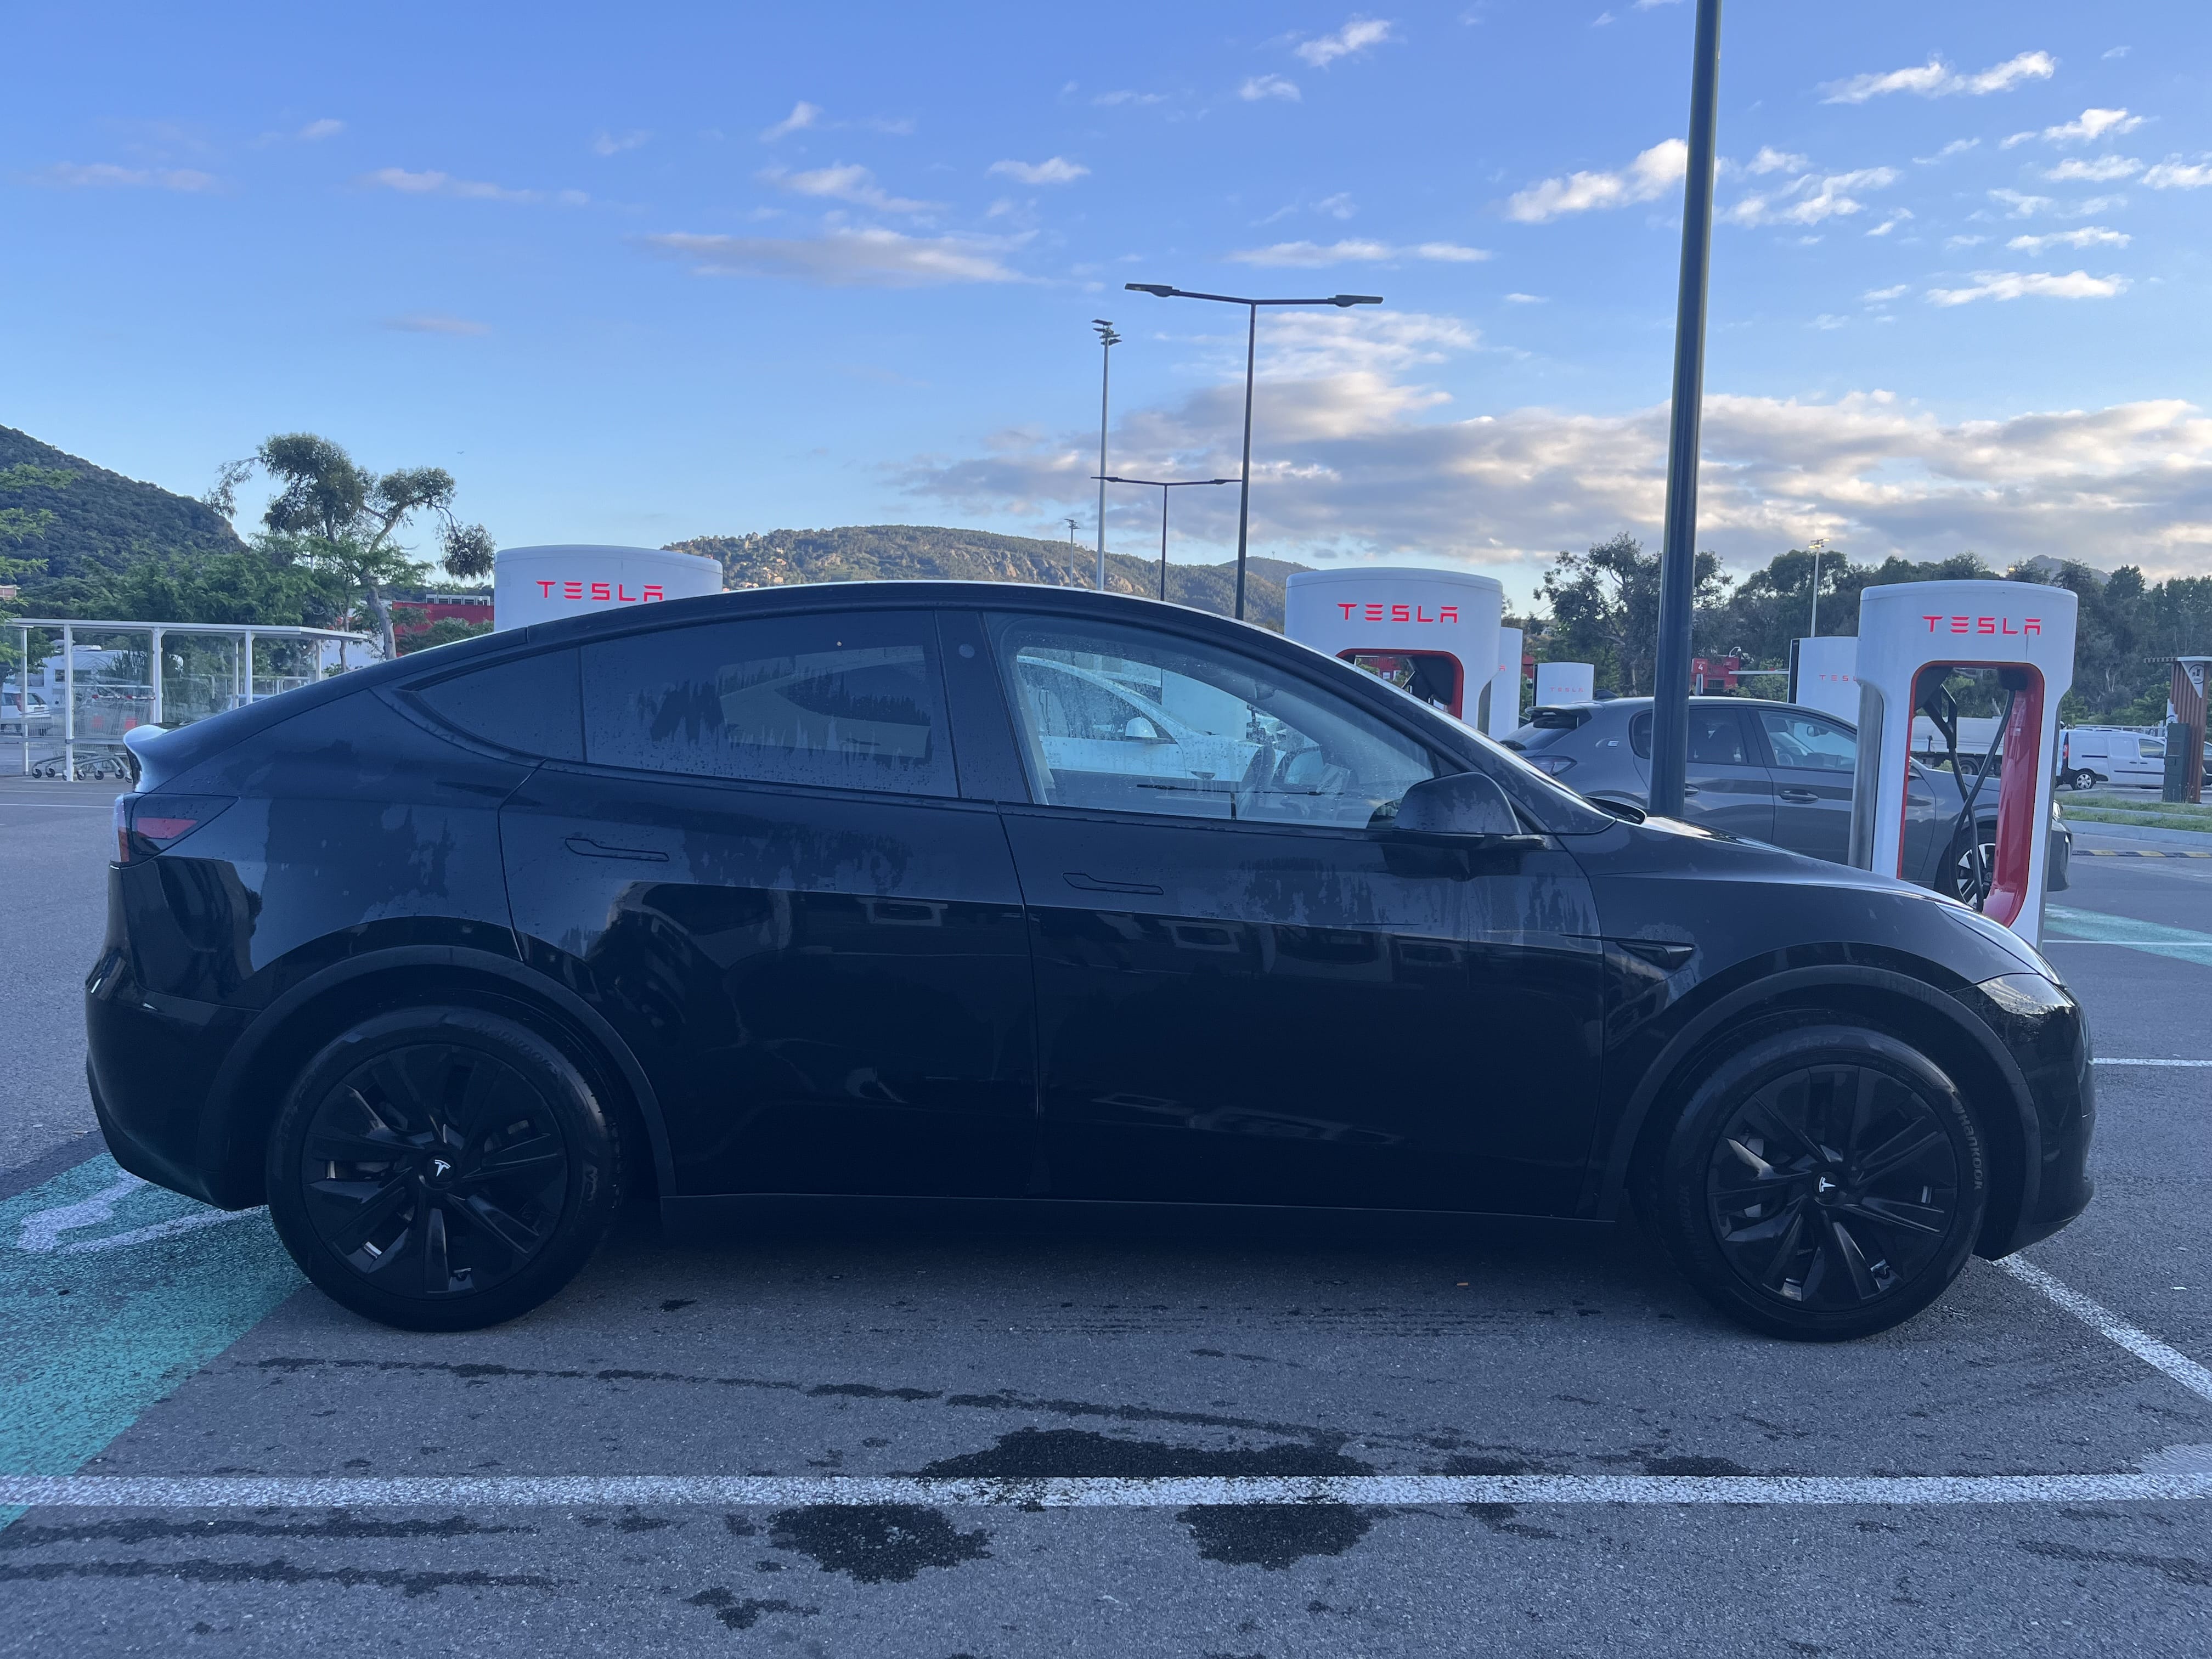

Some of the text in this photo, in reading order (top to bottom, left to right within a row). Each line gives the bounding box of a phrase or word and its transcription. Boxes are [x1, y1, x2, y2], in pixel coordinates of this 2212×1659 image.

[536, 580, 663, 602] TESLA
[1337, 603, 1458, 624] TESLA
[1922, 616, 2041, 635] TESLA
